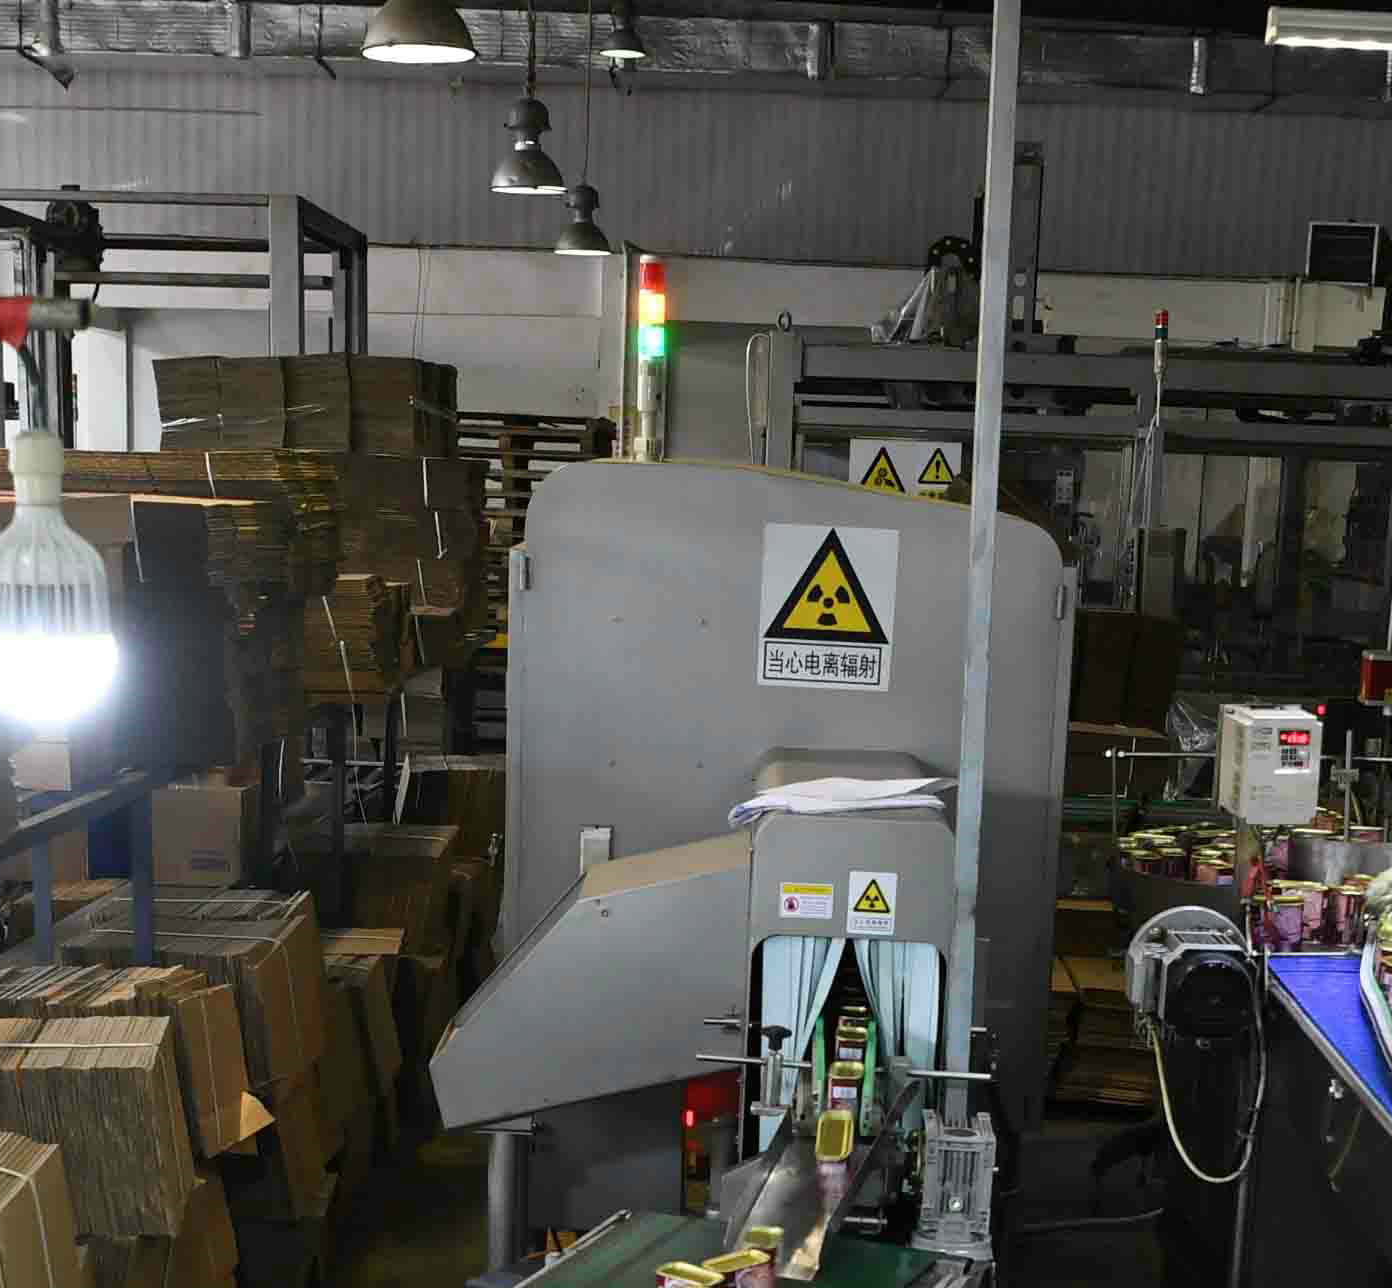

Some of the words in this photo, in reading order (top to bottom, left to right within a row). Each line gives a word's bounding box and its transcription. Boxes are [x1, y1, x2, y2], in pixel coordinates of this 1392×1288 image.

[767, 648, 876, 680] 当心电离辐射
